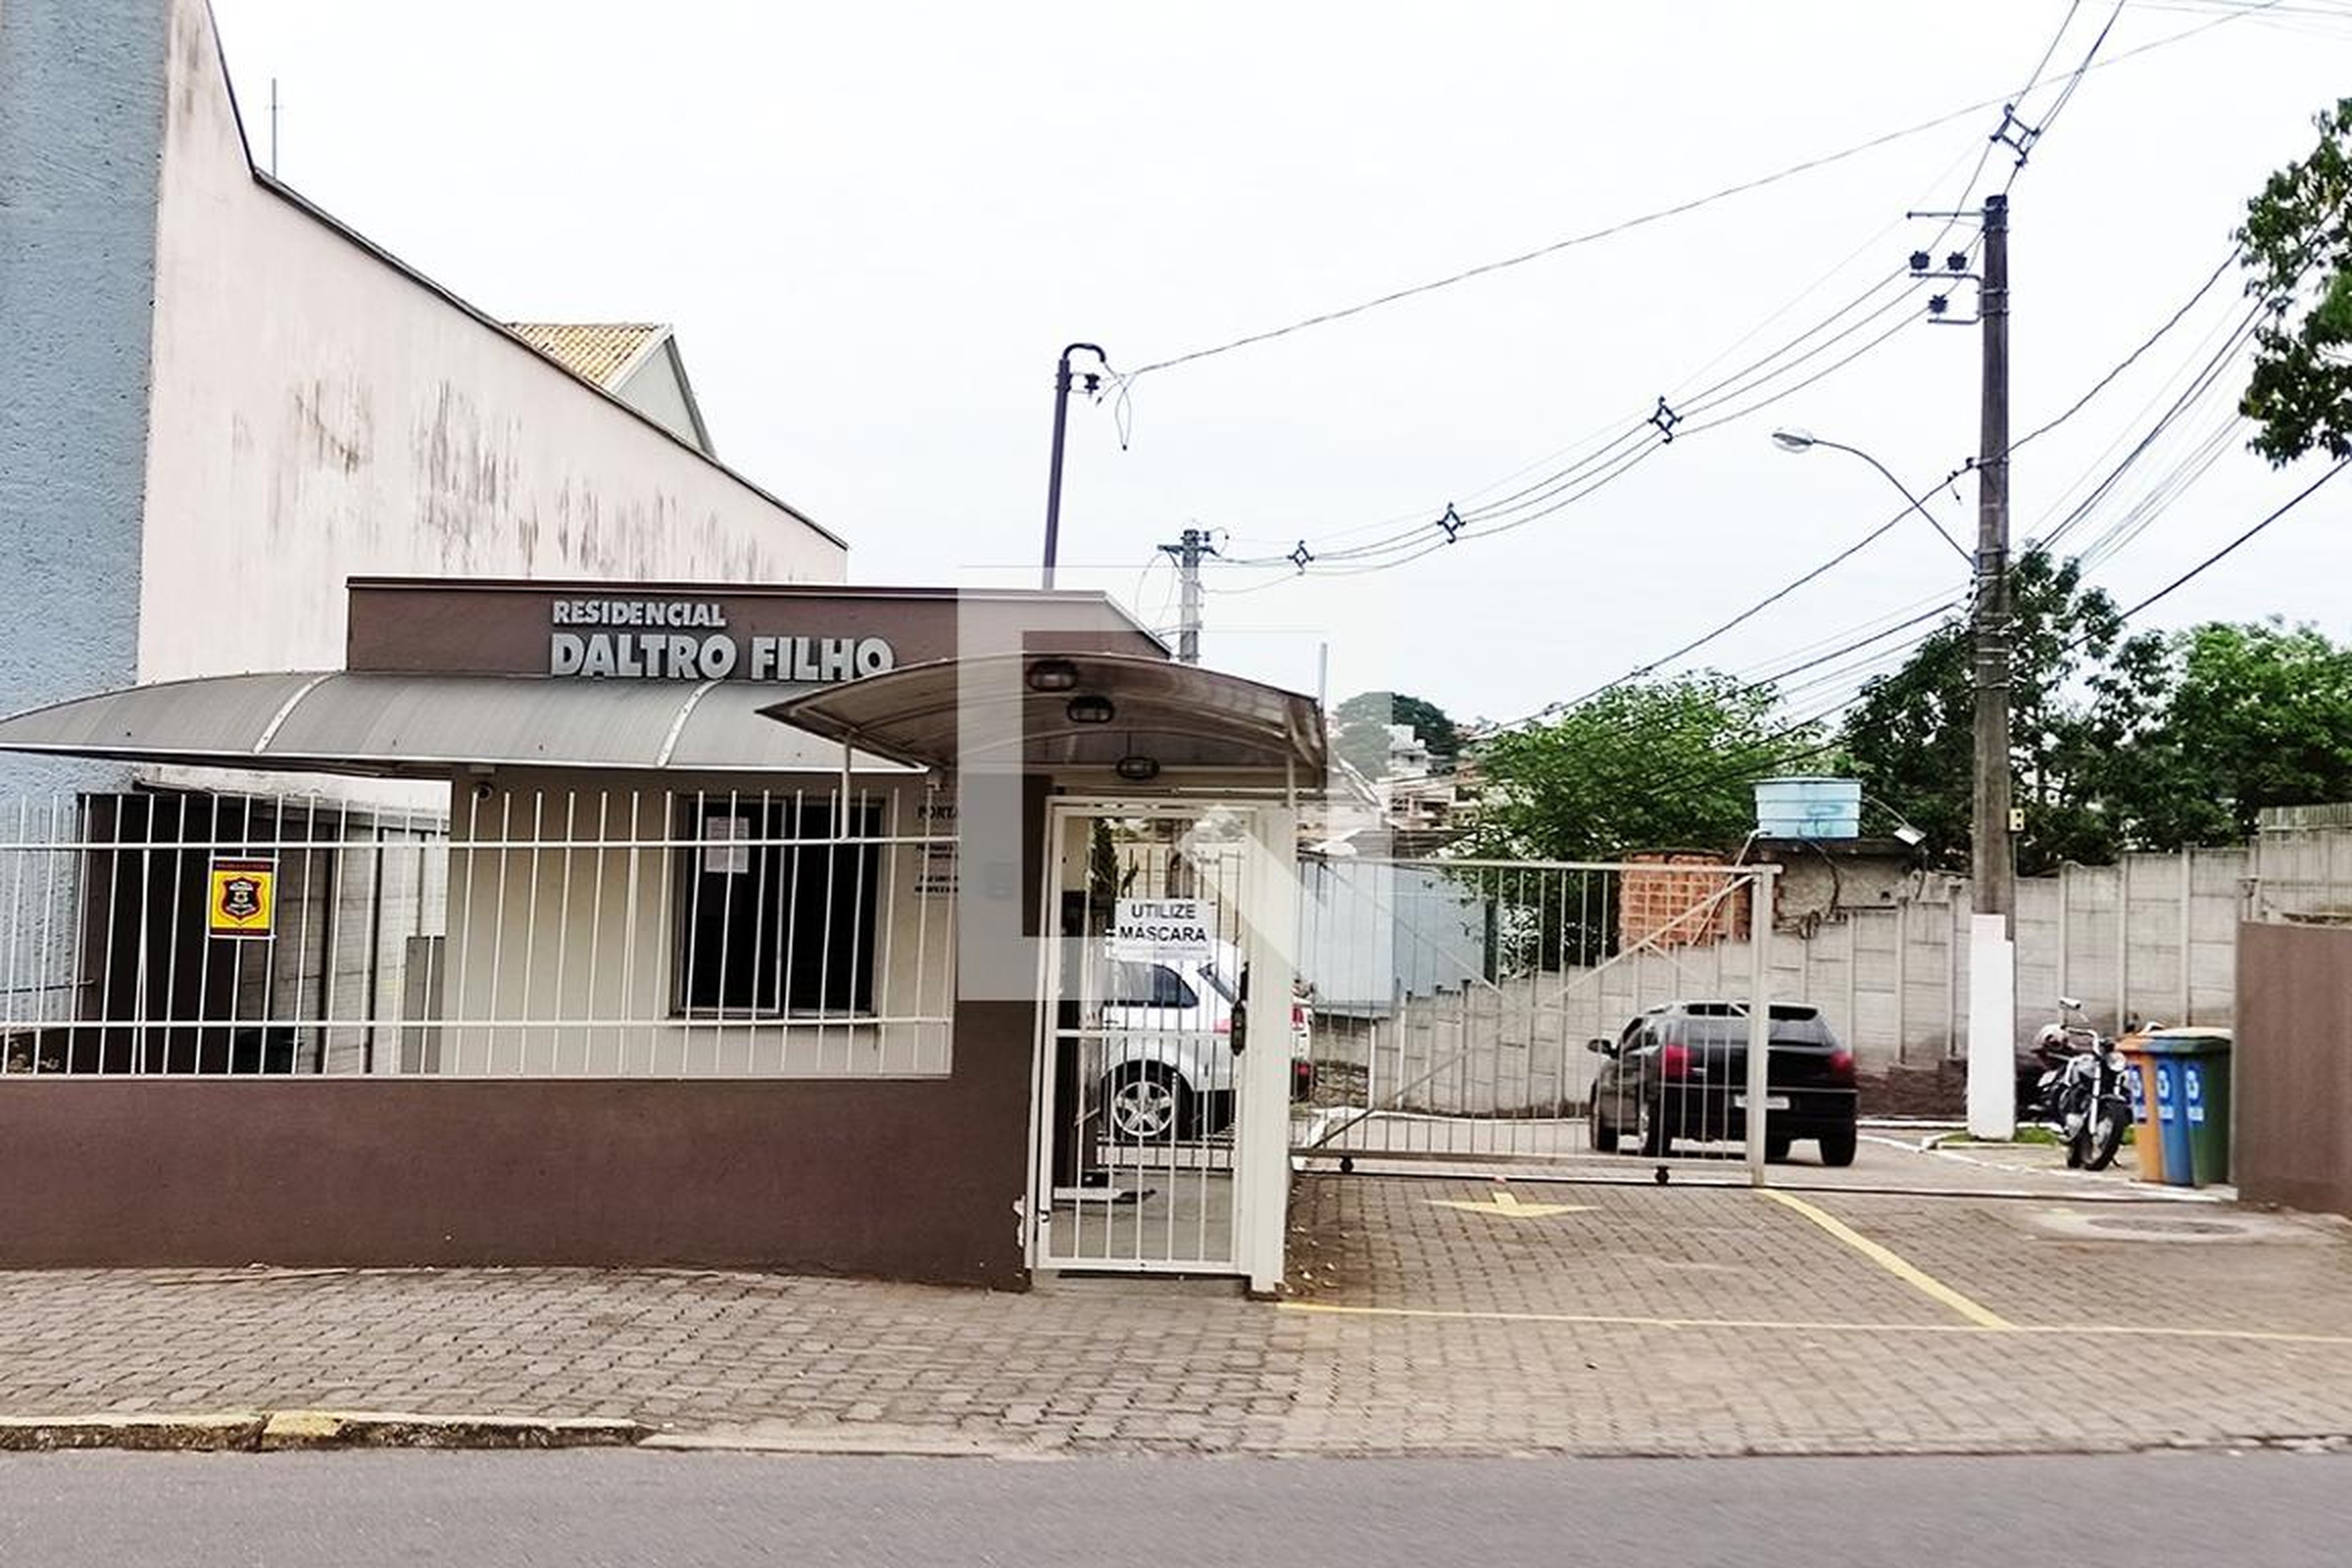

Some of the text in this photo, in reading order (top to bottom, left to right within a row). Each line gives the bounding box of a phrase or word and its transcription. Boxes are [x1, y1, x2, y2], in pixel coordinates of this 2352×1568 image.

[552, 600, 726, 627] RESIDENCIAL
[551, 633, 894, 681] DALTRO FILHO
[1132, 903, 1196, 919] UTILIZE
[1120, 923, 1207, 941] MÁSCARA
